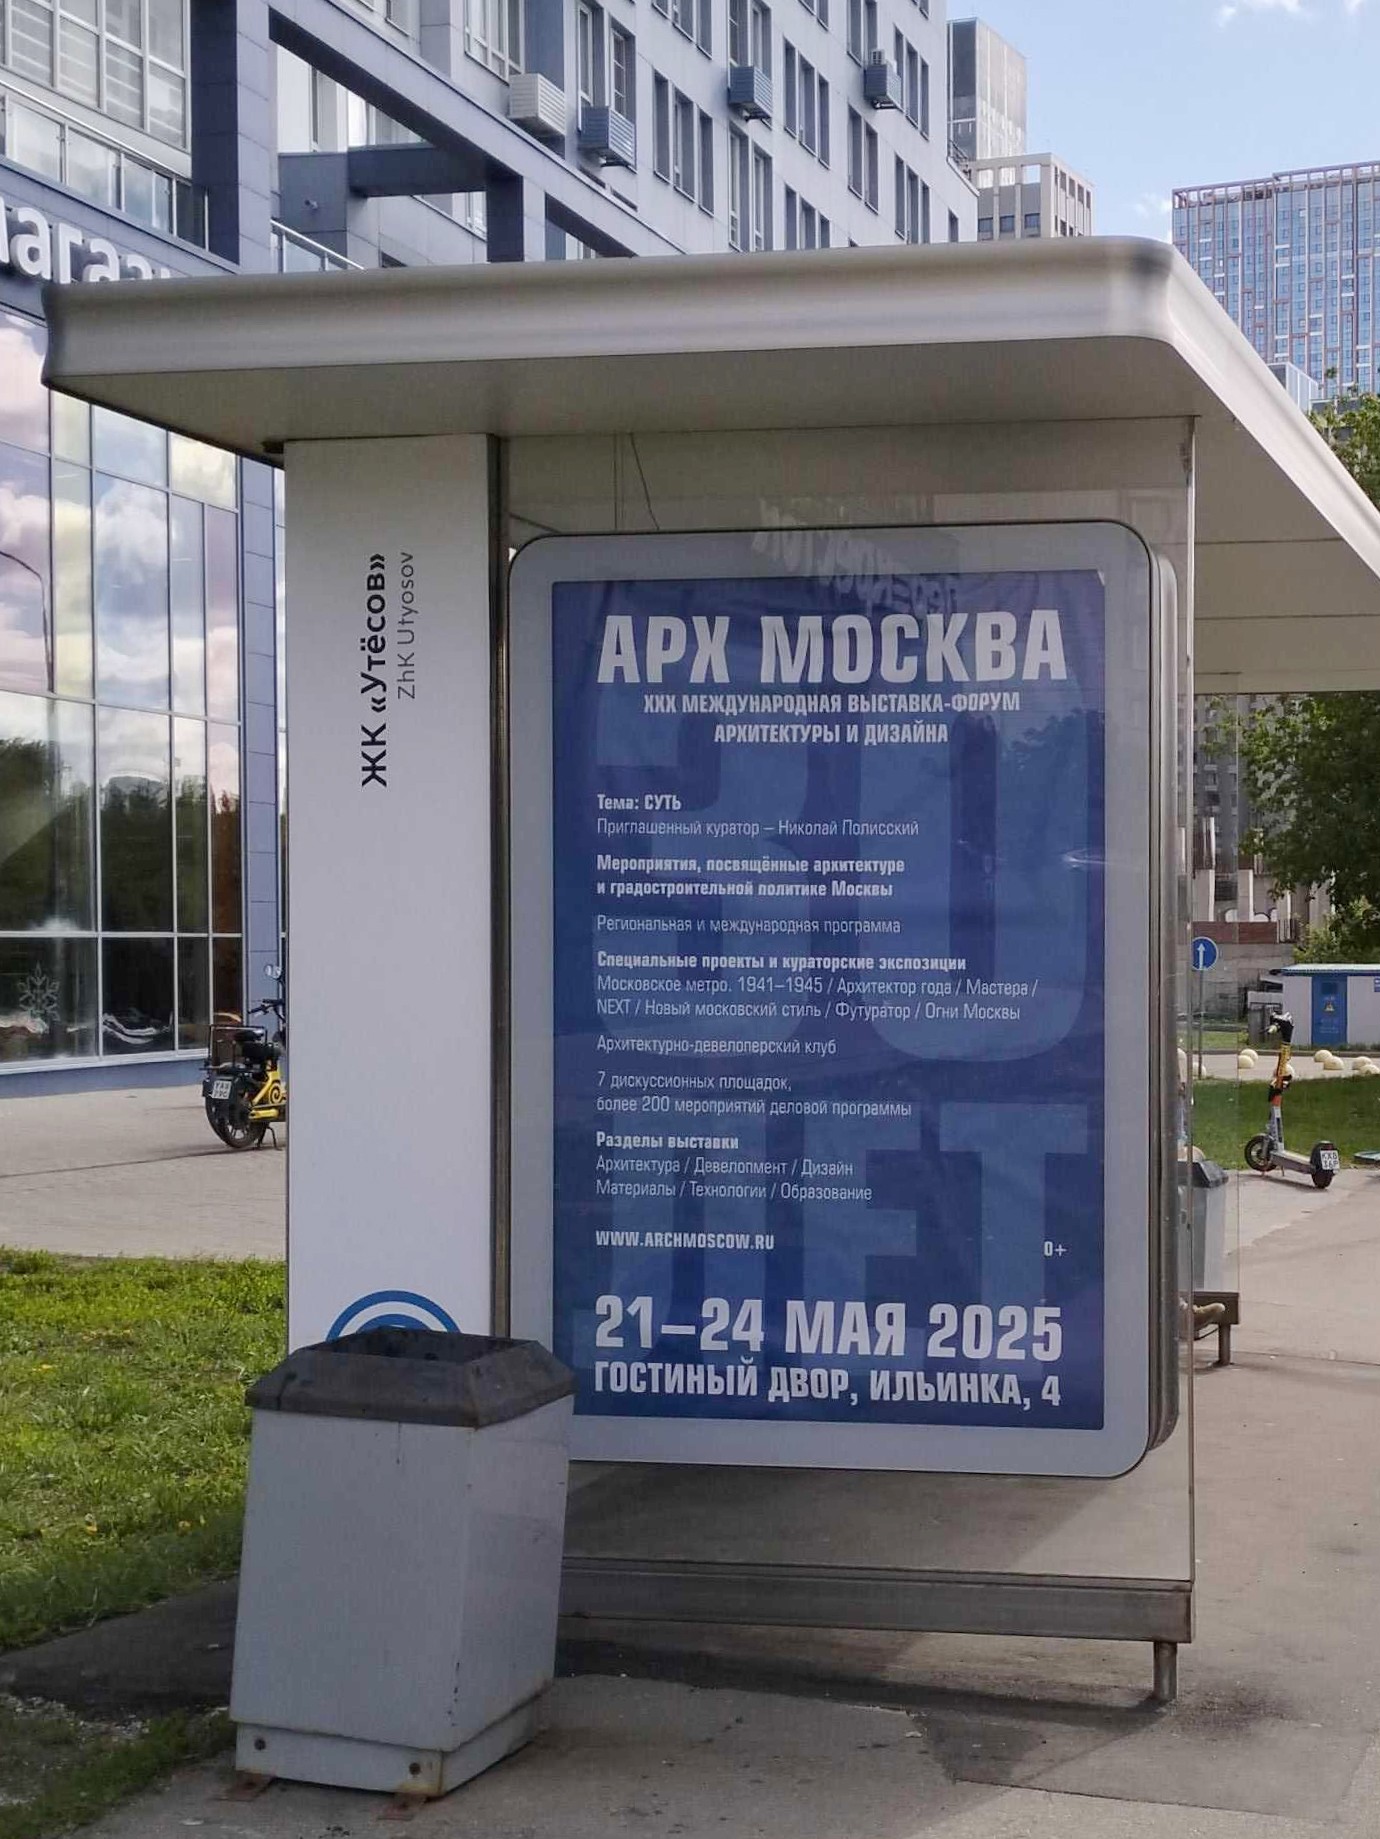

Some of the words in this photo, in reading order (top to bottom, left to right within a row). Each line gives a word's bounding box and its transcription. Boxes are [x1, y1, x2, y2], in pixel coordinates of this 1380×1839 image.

[397, 551, 418, 645] Utyosov
[360, 553, 387, 713] «Утёсов»
[597, 615, 729, 684] АРХ
[760, 609, 1067, 683] МОСКВА
[397, 652, 415, 699] ZhK
[682, 693, 841, 715] МЕЖДУНАРОДНАЯ
[848, 692, 1020, 713] ВЫСТАВКА-ФОРУМ
[714, 724, 840, 744] АРХИТЕКТУРЫ
[847, 724, 859, 743] И
[864, 721, 948, 746] ДИЗАЙНА
[361, 723, 387, 787] ЖК
[597, 794, 639, 811] Тема:
[645, 794, 681, 811] СУТЬ
[597, 818, 701, 837] Приглашенный
[706, 821, 759, 839] куратор
[779, 819, 837, 835] Николай
[842, 819, 918, 835] Полисский
[597, 855, 702, 873] Мероприятия,
[706, 856, 809, 872] посвящённые
[813, 858, 904, 875] архитектуре
[597, 882, 605, 895] и
[610, 880, 753, 895] градостроительной
[758, 882, 826, 896] политике
[832, 880, 892, 897] Москвы
[597, 915, 692, 933] Региональная
[697, 918, 705, 932] и
[710, 917, 819, 936] международная
[824, 918, 901, 937] программа
[597, 950, 697, 970] Специальные
[702, 954, 765, 973] проекты
[769, 956, 778, 969] и
[782, 954, 874, 974] кураторские
[879, 955, 966, 974] экспозиции
[597, 976, 681, 992] Московское
[686, 979, 733, 996] метро.
[737, 976, 823, 994] 1941–1945
[837, 978, 916, 998] Архитектор
[921, 982, 951, 998] года
[966, 979, 1028, 998] Мастера
[597, 998, 630, 1014] NEXT
[645, 1000, 690, 1017] Новый
[695, 1000, 778, 1019] московский
[783, 1003, 821, 1019] стиль
[834, 1002, 911, 1022] Футуратор
[924, 1003, 959, 1020] Огни
[963, 1004, 1020, 1021] Москвы
[597, 1035, 801, 1054] Архитектурно-девелоперский
[805, 1039, 836, 1058] клуб
[597, 1071, 606, 1087] 7
[610, 1074, 715, 1092] дискуссионных
[720, 1075, 792, 1094] площадок,
[597, 1095, 638, 1113] более
[642, 1096, 669, 1114] 200
[675, 1097, 765, 1117] мероприятий
[770, 1098, 828, 1117] деловой
[833, 1102, 911, 1119] программы
[596, 1132, 663, 1148] Разделы
[668, 1134, 739, 1151] выставки
[596, 1156, 680, 1177] Архитектура
[694, 1158, 787, 1177] Девелопмент
[801, 1159, 853, 1178] Дизайн
[596, 1180, 675, 1198] Материалы
[690, 1182, 766, 1199] Технологии
[780, 1183, 872, 1201] Образование
[596, 1231, 774, 1251] WWW.ARCHMOSCOW.RU
[1043, 1241, 1067, 1257] 0+
[595, 1295, 764, 1352] 21–24
[785, 1299, 906, 1356] МАЯ
[927, 1304, 1063, 1361] 2025
[595, 1356, 757, 1396] ГОСТИНЫЙ
[768, 1366, 857, 1405] ДВОР,
[870, 1370, 1030, 1411] ИЛЬИНКА,
[1042, 1373, 1060, 1407] 4
